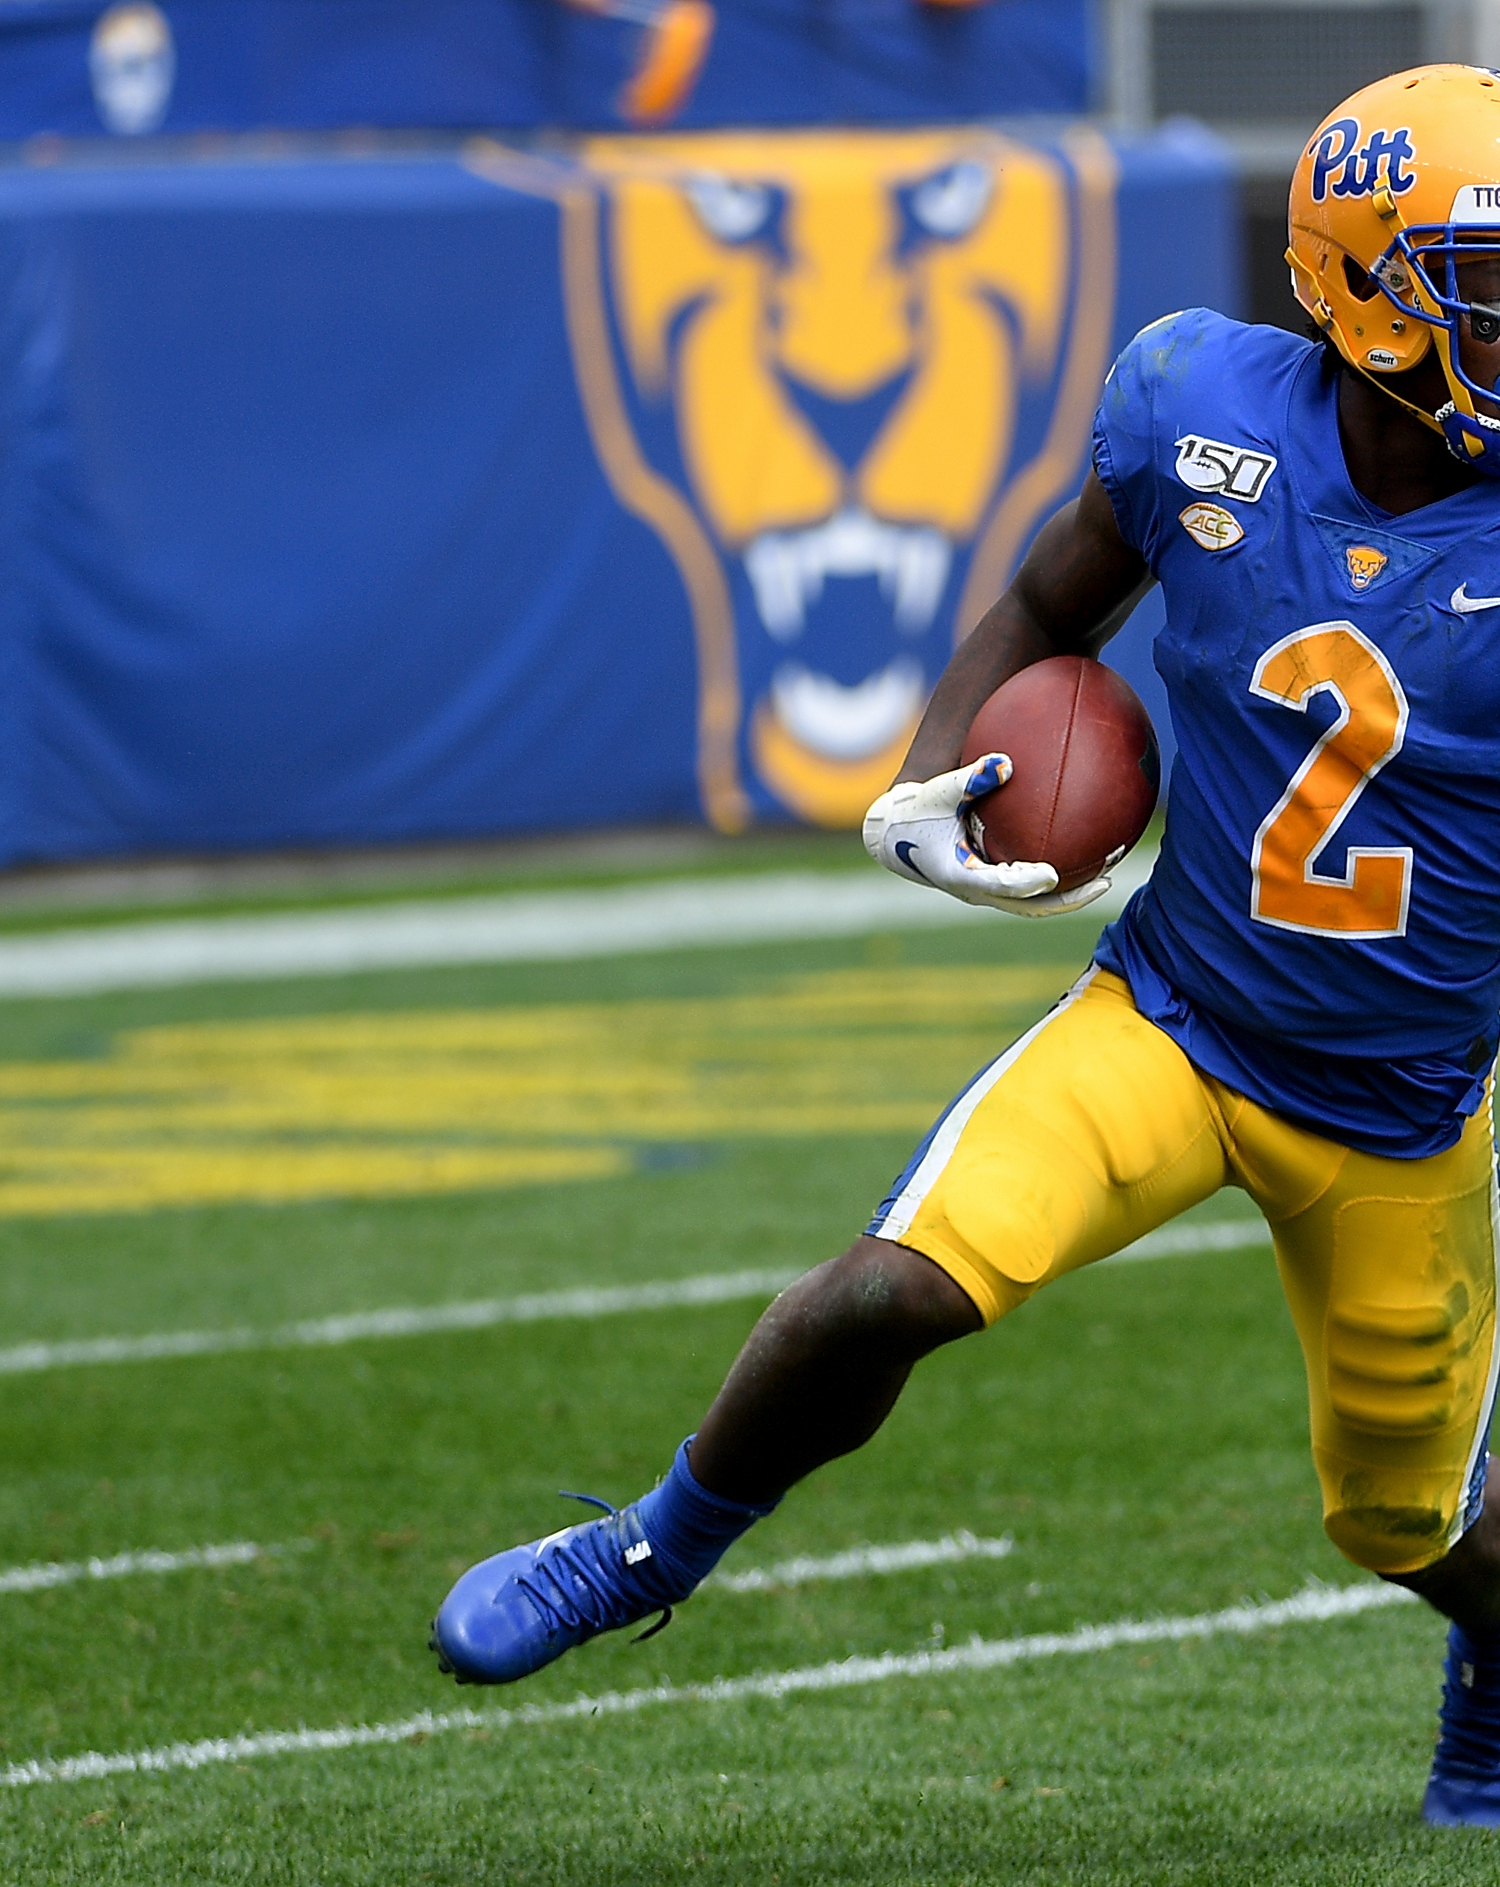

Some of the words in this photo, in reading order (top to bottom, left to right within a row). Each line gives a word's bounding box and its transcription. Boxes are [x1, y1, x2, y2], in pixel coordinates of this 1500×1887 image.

[1308, 118, 1414, 201] Pitt
[1369, 353, 1395, 366] schutt
[1182, 439, 1272, 498] 150
[1189, 514, 1233, 536] ACC
[1249, 619, 1413, 940] 2
